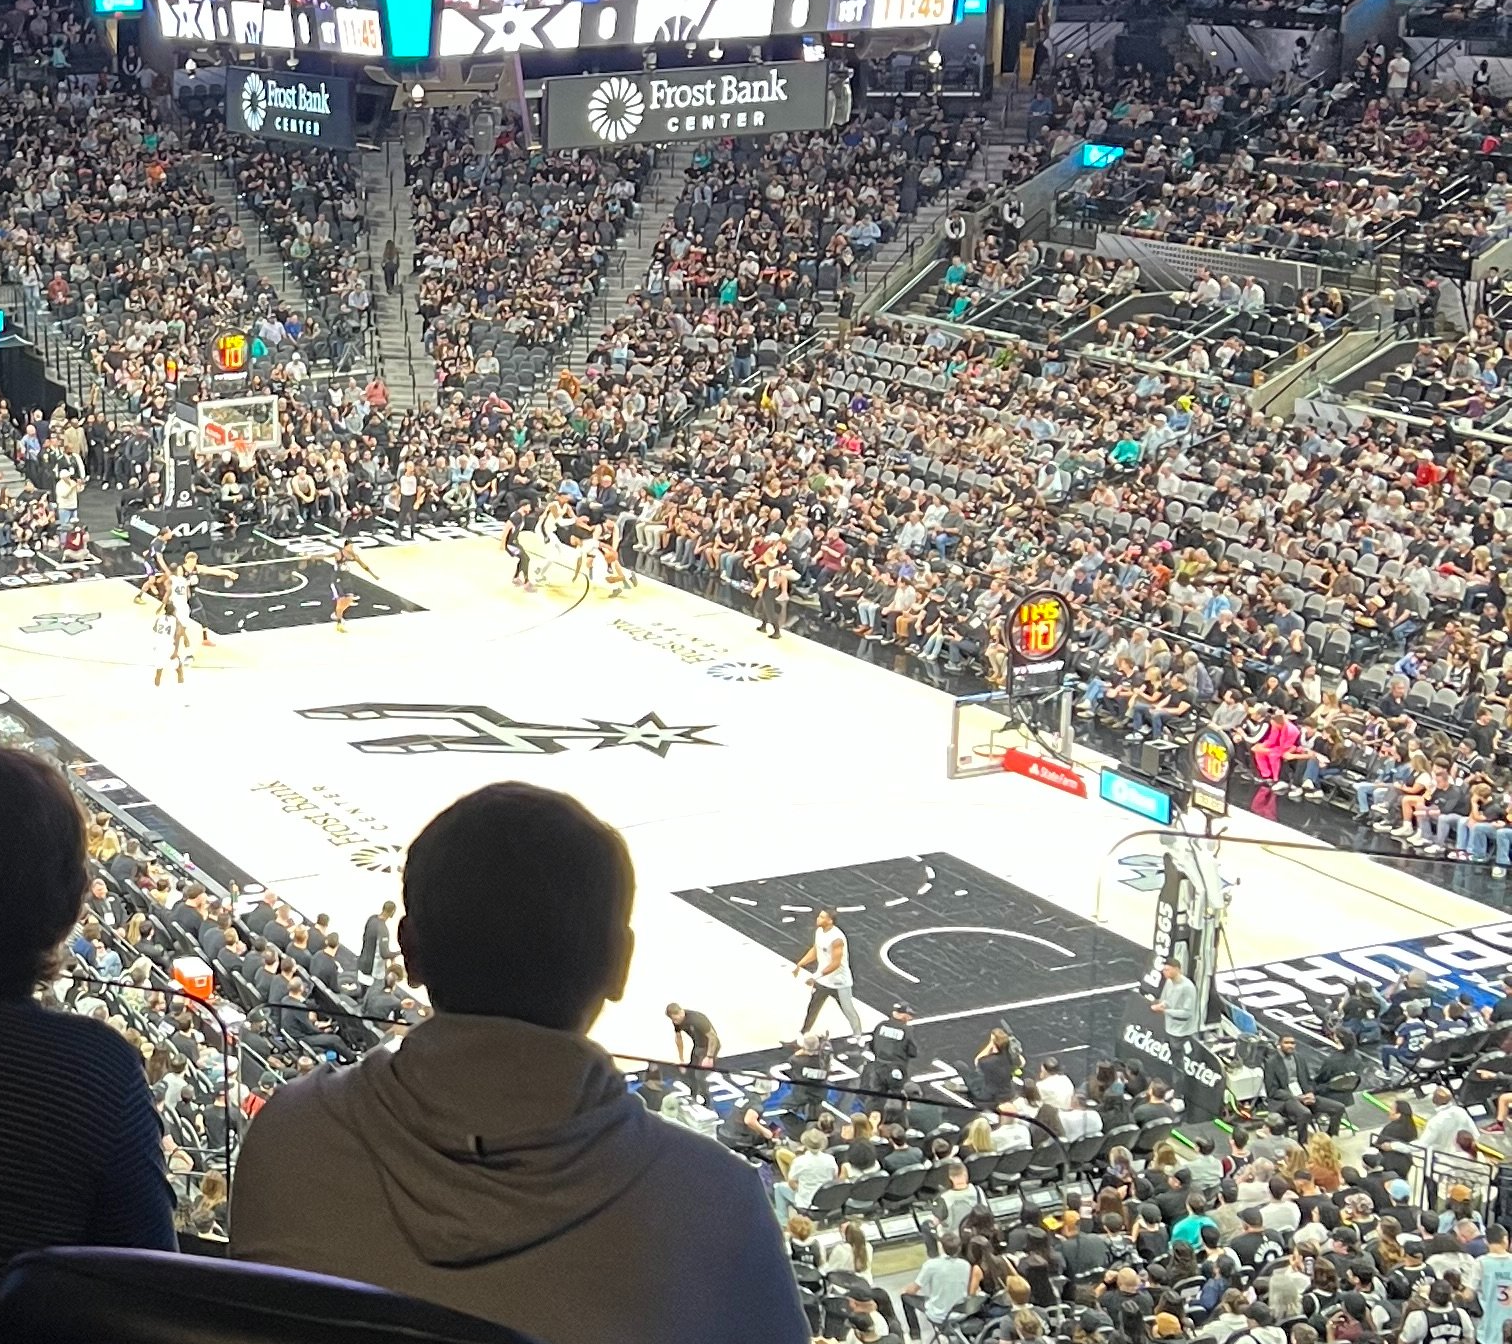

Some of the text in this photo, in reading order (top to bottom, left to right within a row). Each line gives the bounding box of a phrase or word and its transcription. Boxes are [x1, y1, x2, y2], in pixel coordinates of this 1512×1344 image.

[342, 18, 378, 49] 11:45
[266, 81, 331, 115] Frost Bank
[649, 69, 788, 110] Frost Bank
[274, 116, 322, 137] CENTER
[667, 110, 766, 133] CENTER
[1030, 619, 1056, 650] 10
[250, 780, 370, 847] Frost Bank
[1497, 1284, 1509, 1303] 3
